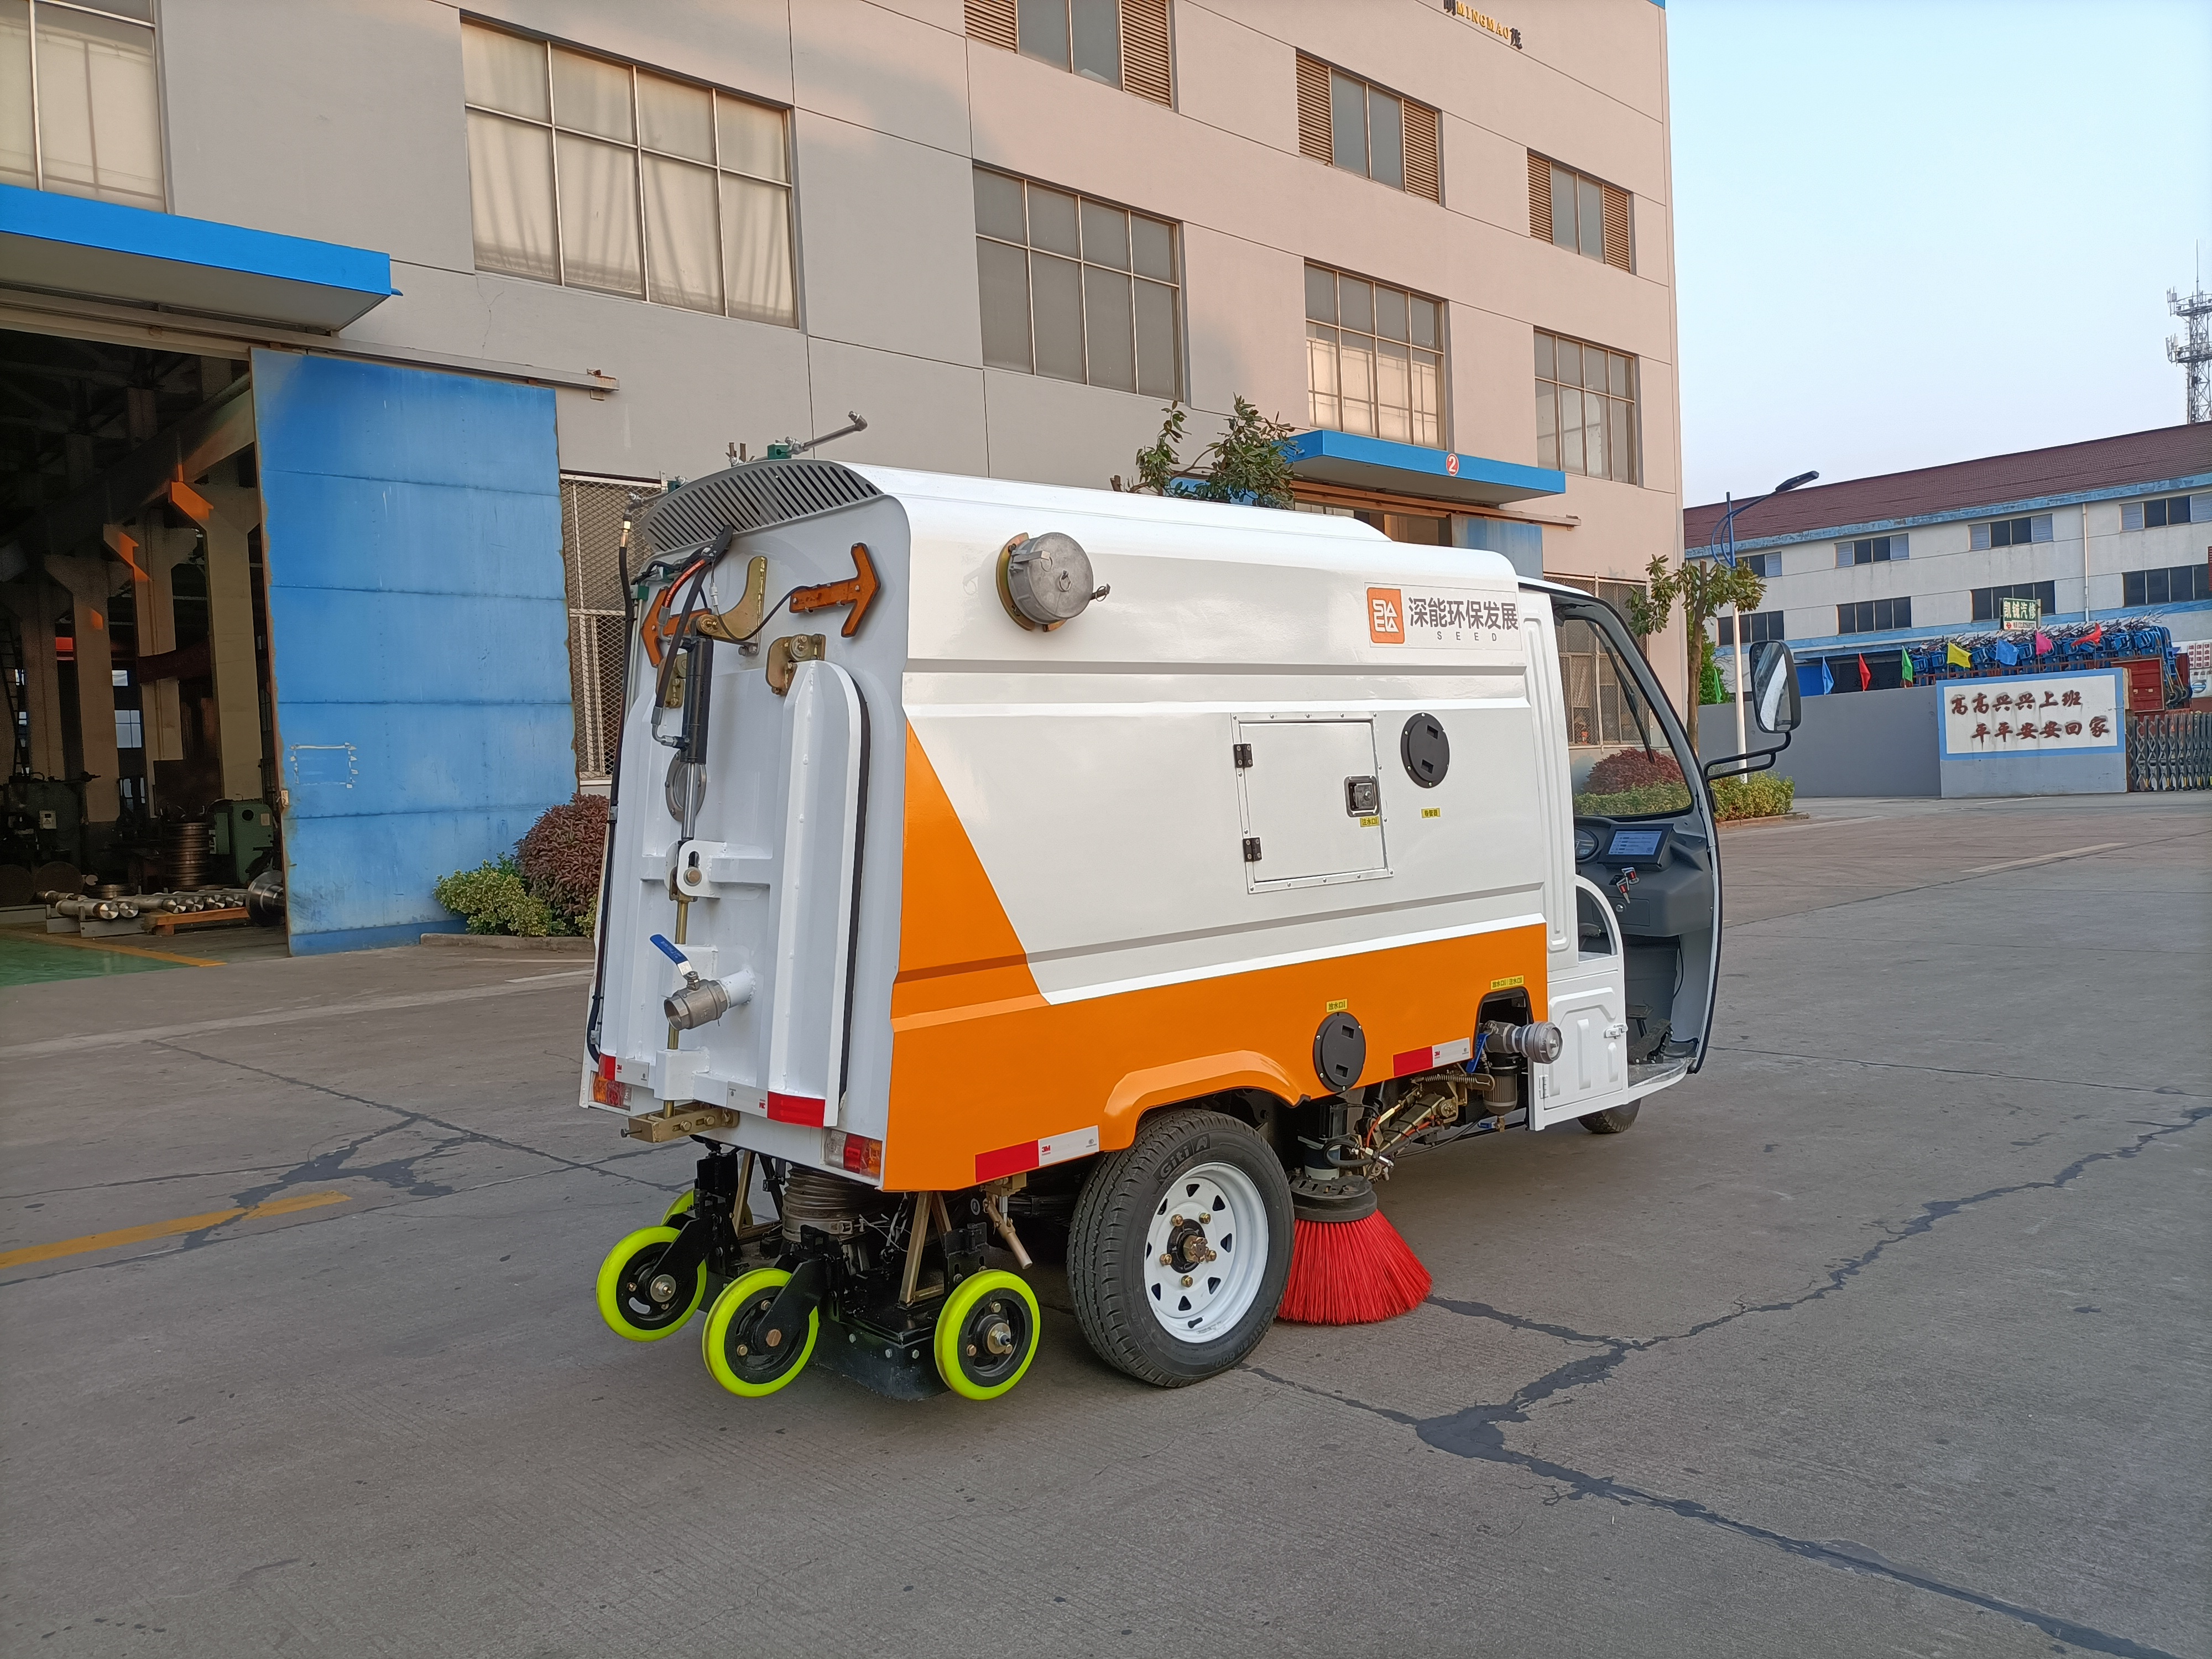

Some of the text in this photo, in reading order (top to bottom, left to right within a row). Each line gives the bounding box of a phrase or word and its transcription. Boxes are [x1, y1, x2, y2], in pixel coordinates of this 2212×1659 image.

[1457, 1, 1509, 39] MINGMAO
[1448, 456, 1456, 472] 2
[1408, 597, 1519, 630] 深能环保发展
[1437, 631, 1497, 641] SEED
[1950, 690, 2082, 715] 高高兴兴上班
[1971, 716, 2110, 743] 平平安安回家
[1160, 1146, 1190, 1178] Giti
